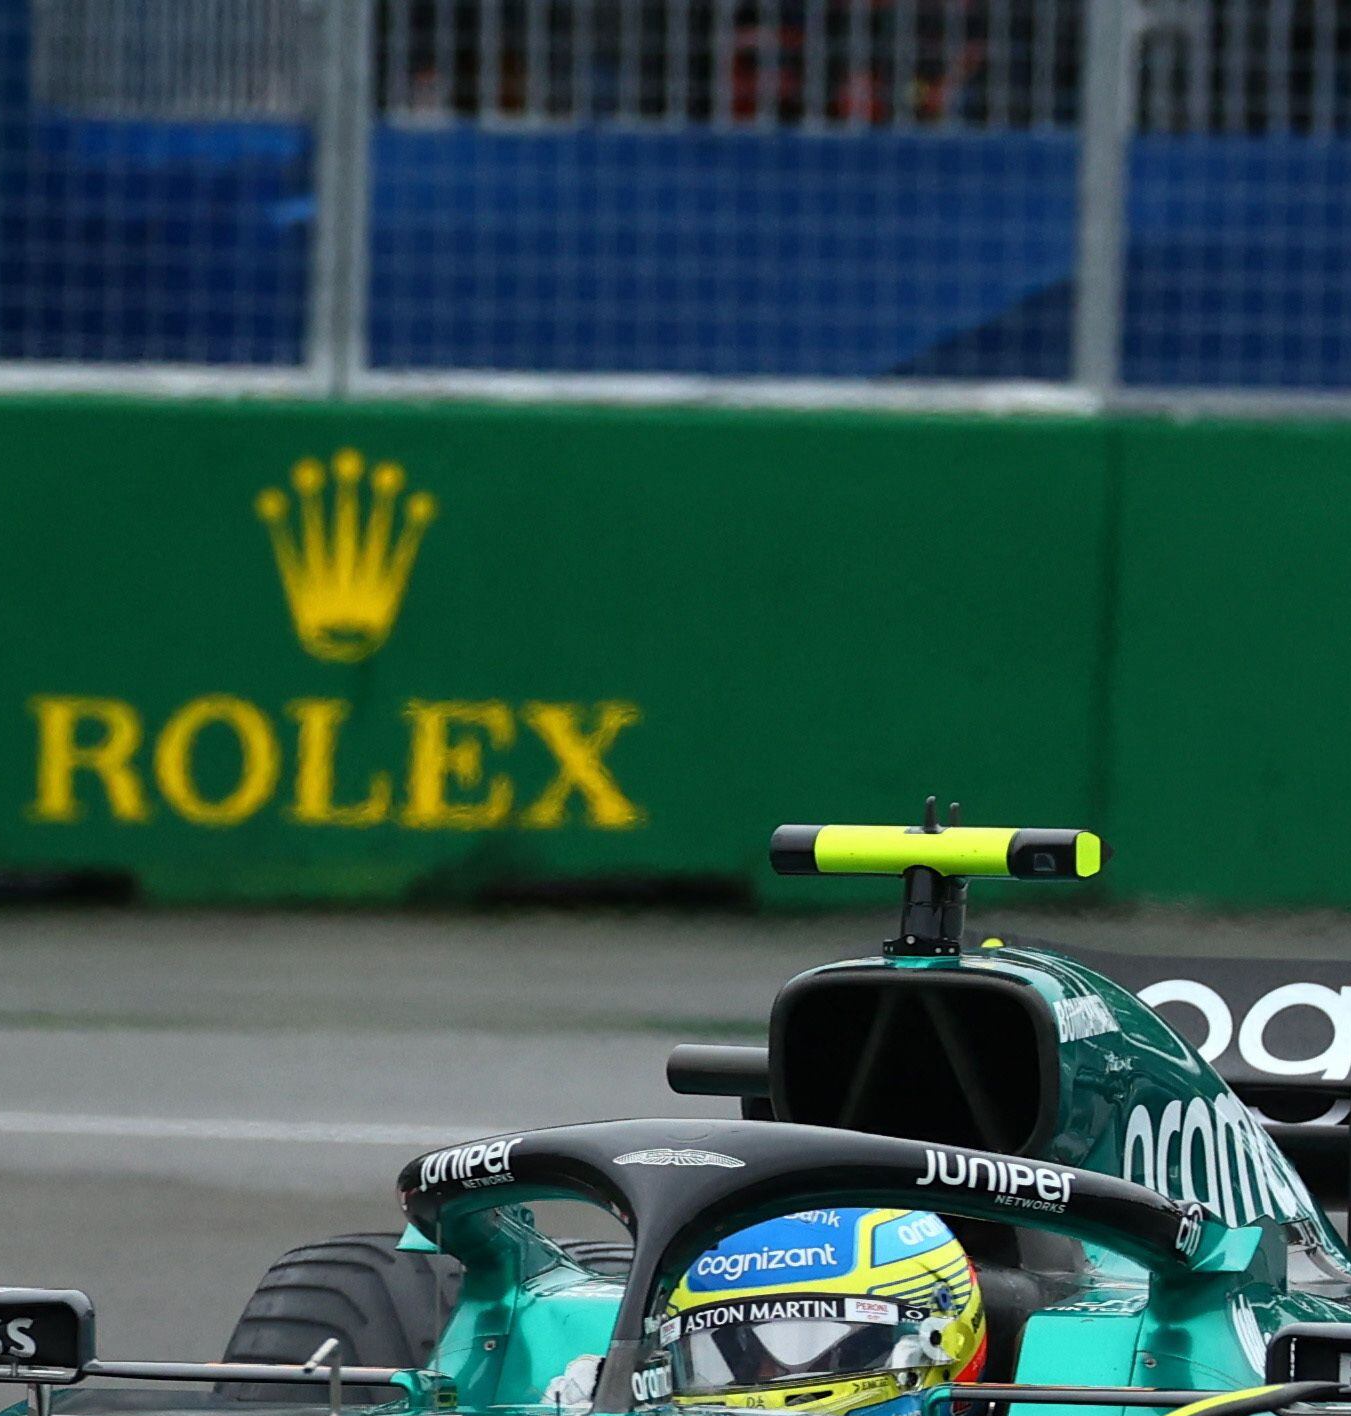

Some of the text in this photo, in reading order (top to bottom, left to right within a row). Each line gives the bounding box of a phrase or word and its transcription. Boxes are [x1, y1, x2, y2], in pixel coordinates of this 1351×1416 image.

[28, 695, 644, 830] ROLEX
[462, 1172, 516, 1190] NETWORKS
[994, 1194, 1069, 1214] NETWORKS
[698, 1243, 838, 1281] cognizant
[684, 1304, 744, 1333] ASTON
[750, 1300, 838, 1321] MARTIN
